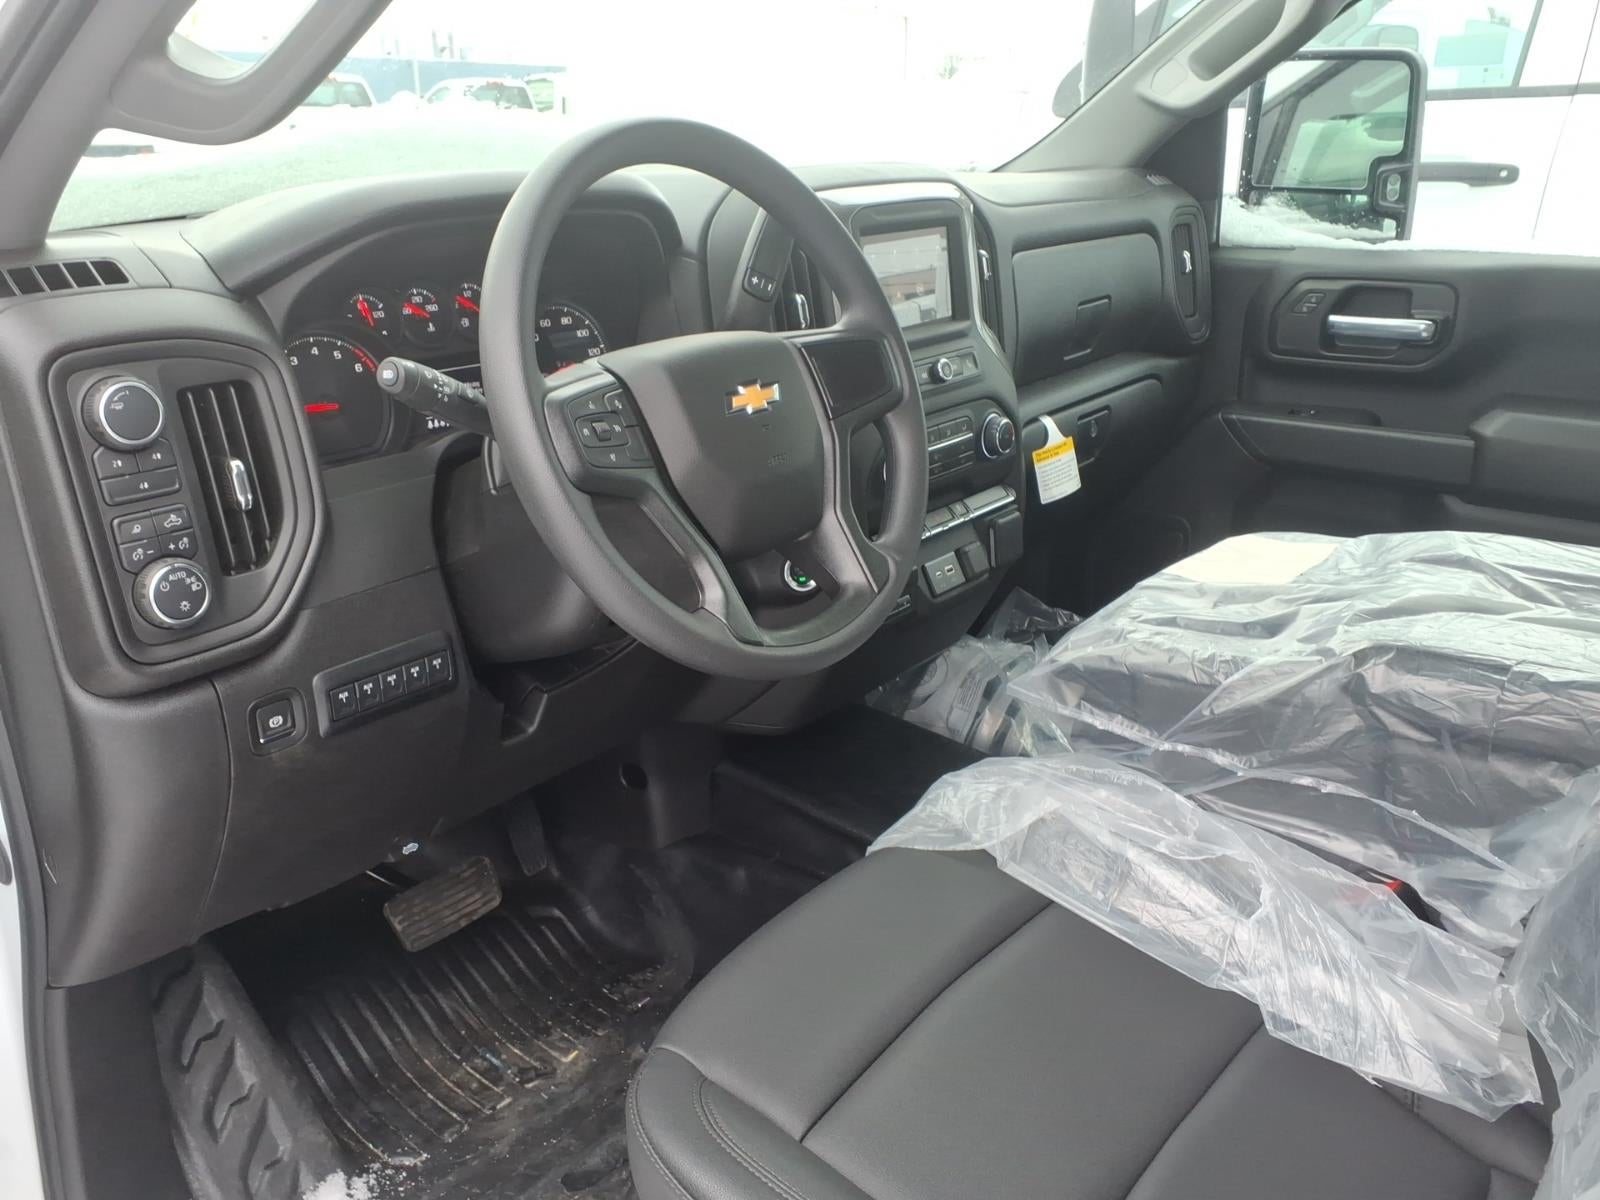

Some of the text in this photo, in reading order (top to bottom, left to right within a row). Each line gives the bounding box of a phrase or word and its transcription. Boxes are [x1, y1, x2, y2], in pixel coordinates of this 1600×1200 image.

[540, 318, 551, 327] 60
[561, 316, 572, 325] 80
[576, 329, 589, 337] 100
[311, 346, 319, 355] 4
[333, 350, 342, 359] 5
[587, 347, 600, 356] 120
[290, 356, 298, 365] 3
[354, 363, 363, 372] 6
[169, 571, 186, 581] AUTO
